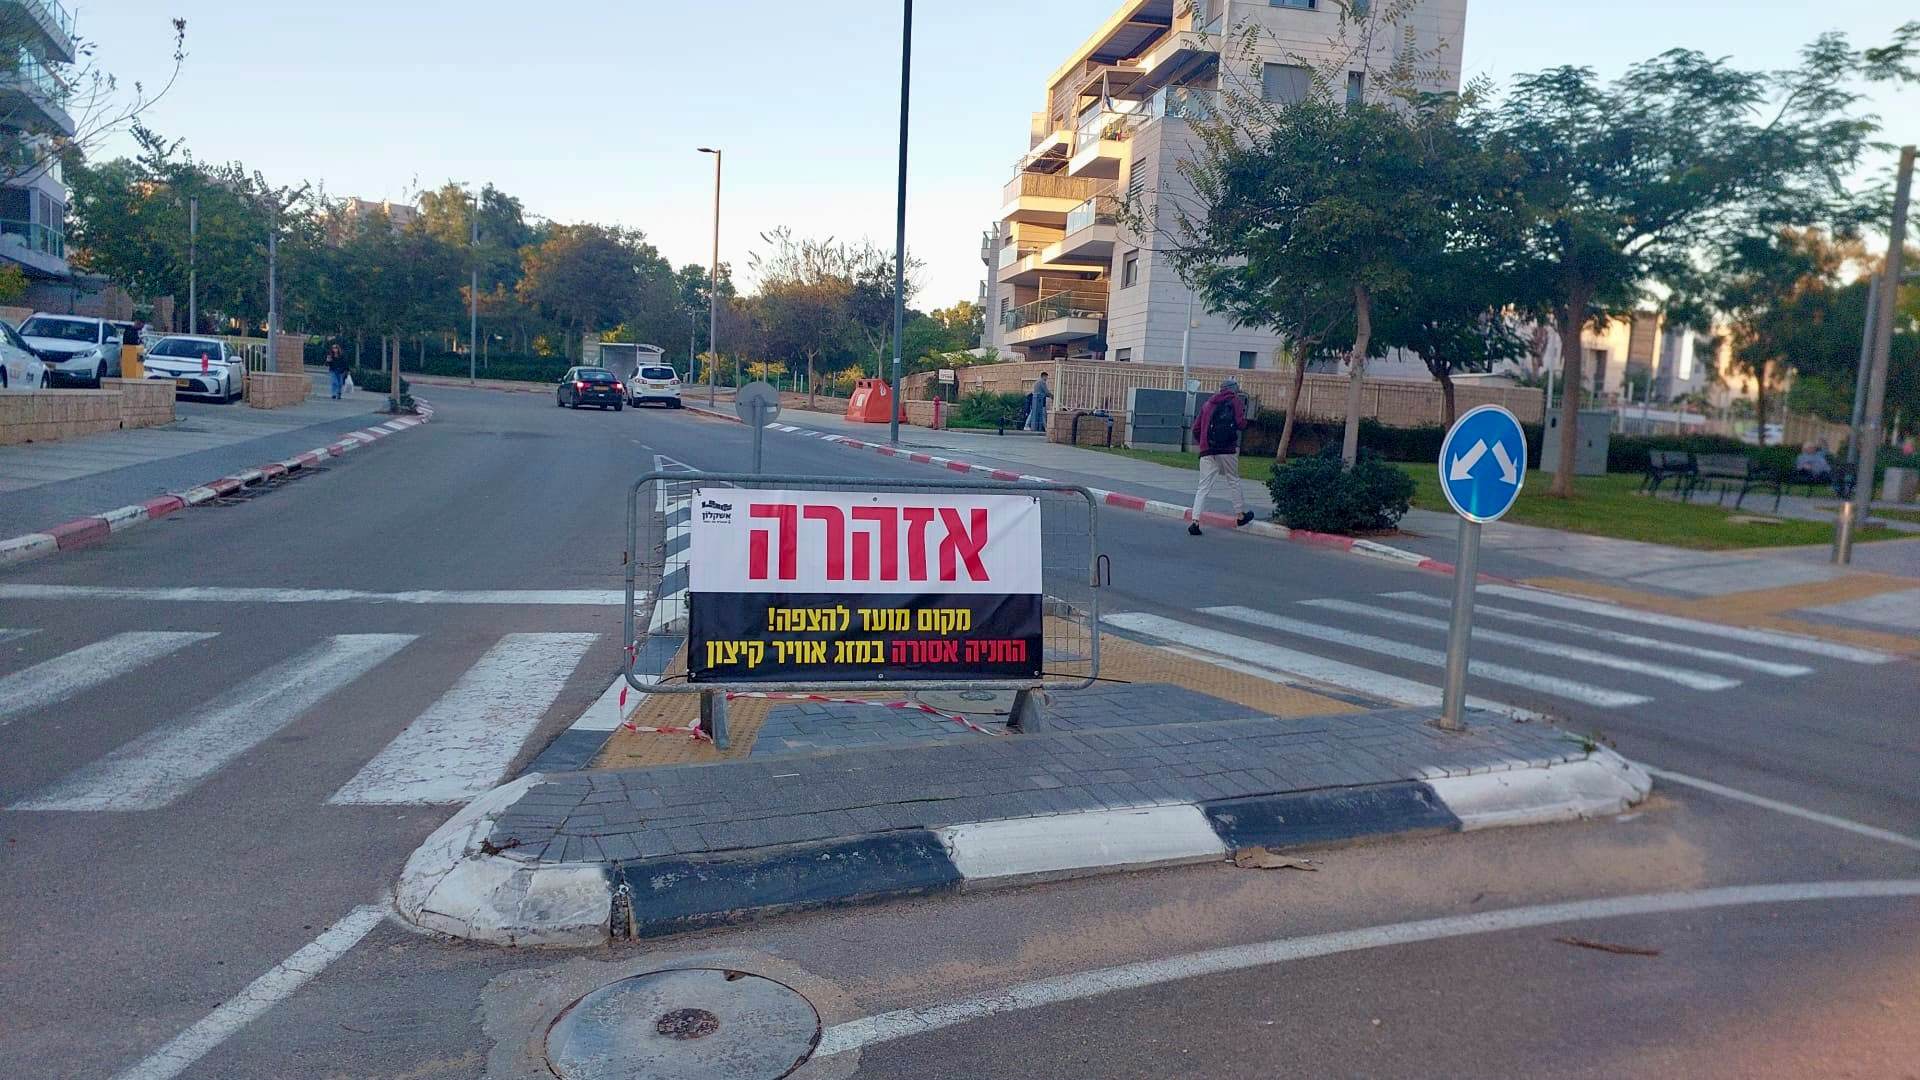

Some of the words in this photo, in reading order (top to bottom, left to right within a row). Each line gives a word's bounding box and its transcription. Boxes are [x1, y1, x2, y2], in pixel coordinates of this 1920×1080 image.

[702, 511, 731, 521] אשקלון
[749, 503, 990, 582] אזהרה
[768, 605, 850, 632] להצפה!
[857, 608, 910, 632] מועד
[917, 608, 971, 635] מקום
[706, 640, 765, 669] קיצון
[772, 640, 827, 664] אוויר
[834, 640, 885, 664] במזג
[892, 639, 959, 663] אסורה
[965, 639, 1026, 663] החניה
